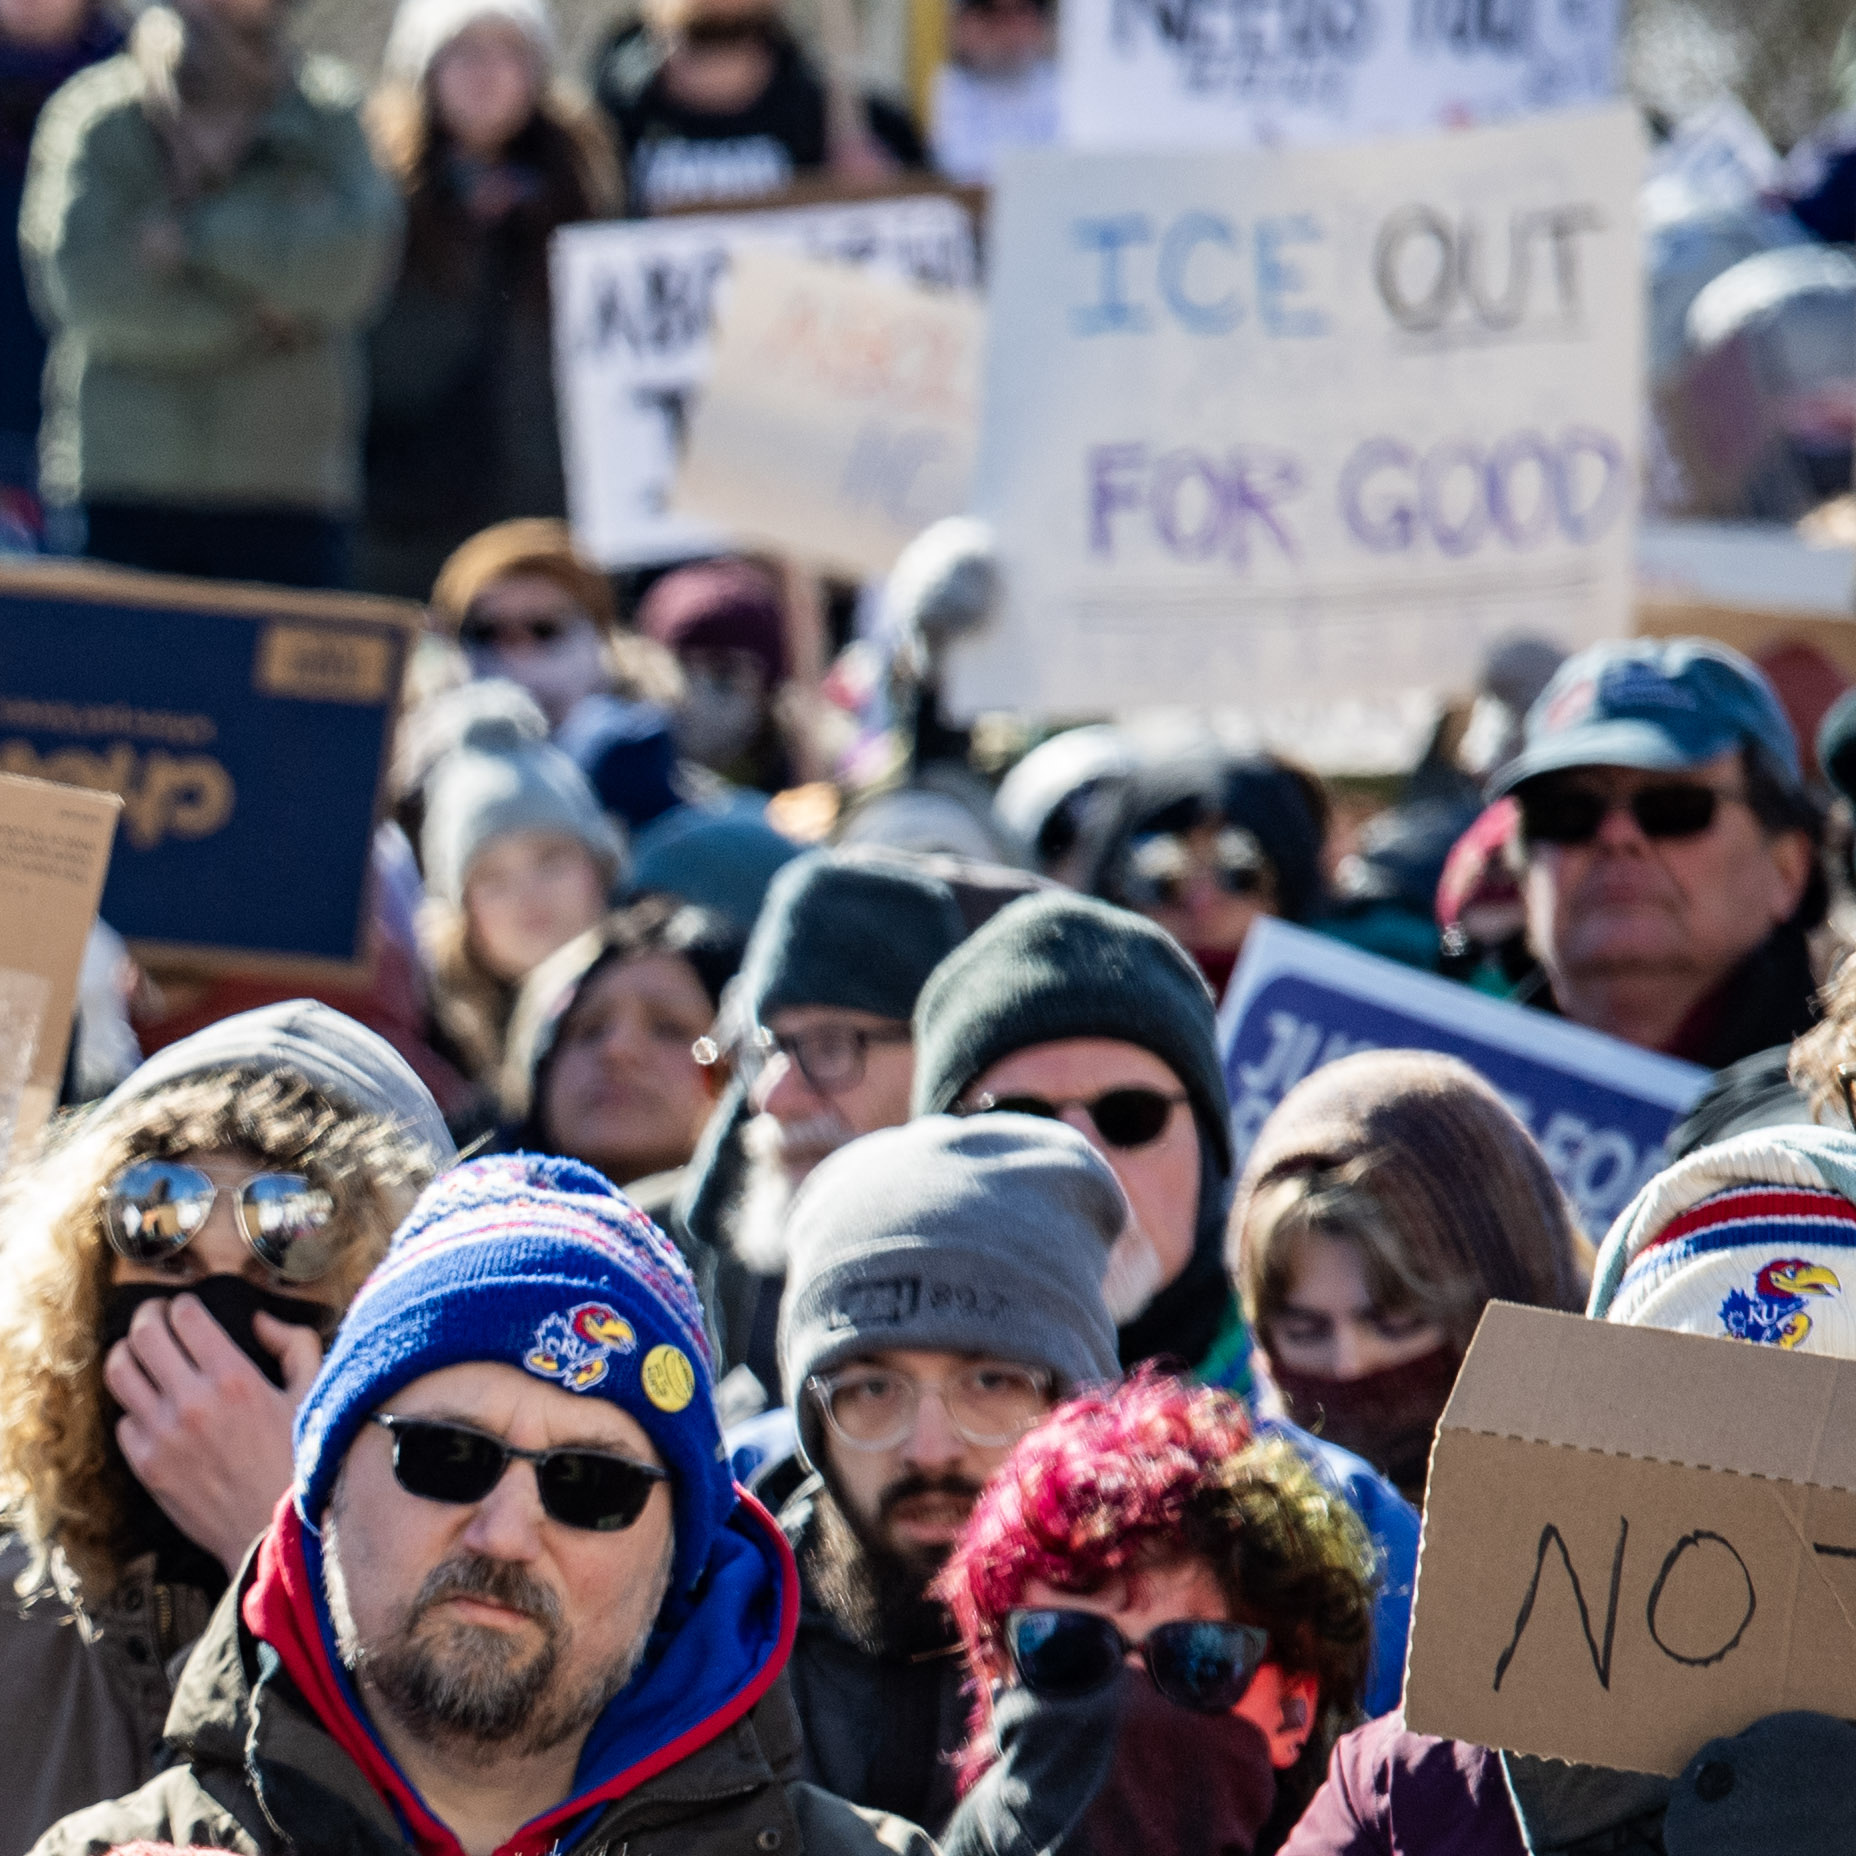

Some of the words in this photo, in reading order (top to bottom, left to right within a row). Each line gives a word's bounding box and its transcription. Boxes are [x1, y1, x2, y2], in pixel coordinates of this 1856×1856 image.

[1067, 208, 1336, 341] ICE
[1371, 201, 1606, 334] OUT
[1086, 439, 1304, 577] FOR
[1337, 420, 1626, 562] GOOD
[1493, 1515, 1757, 1693] NO
